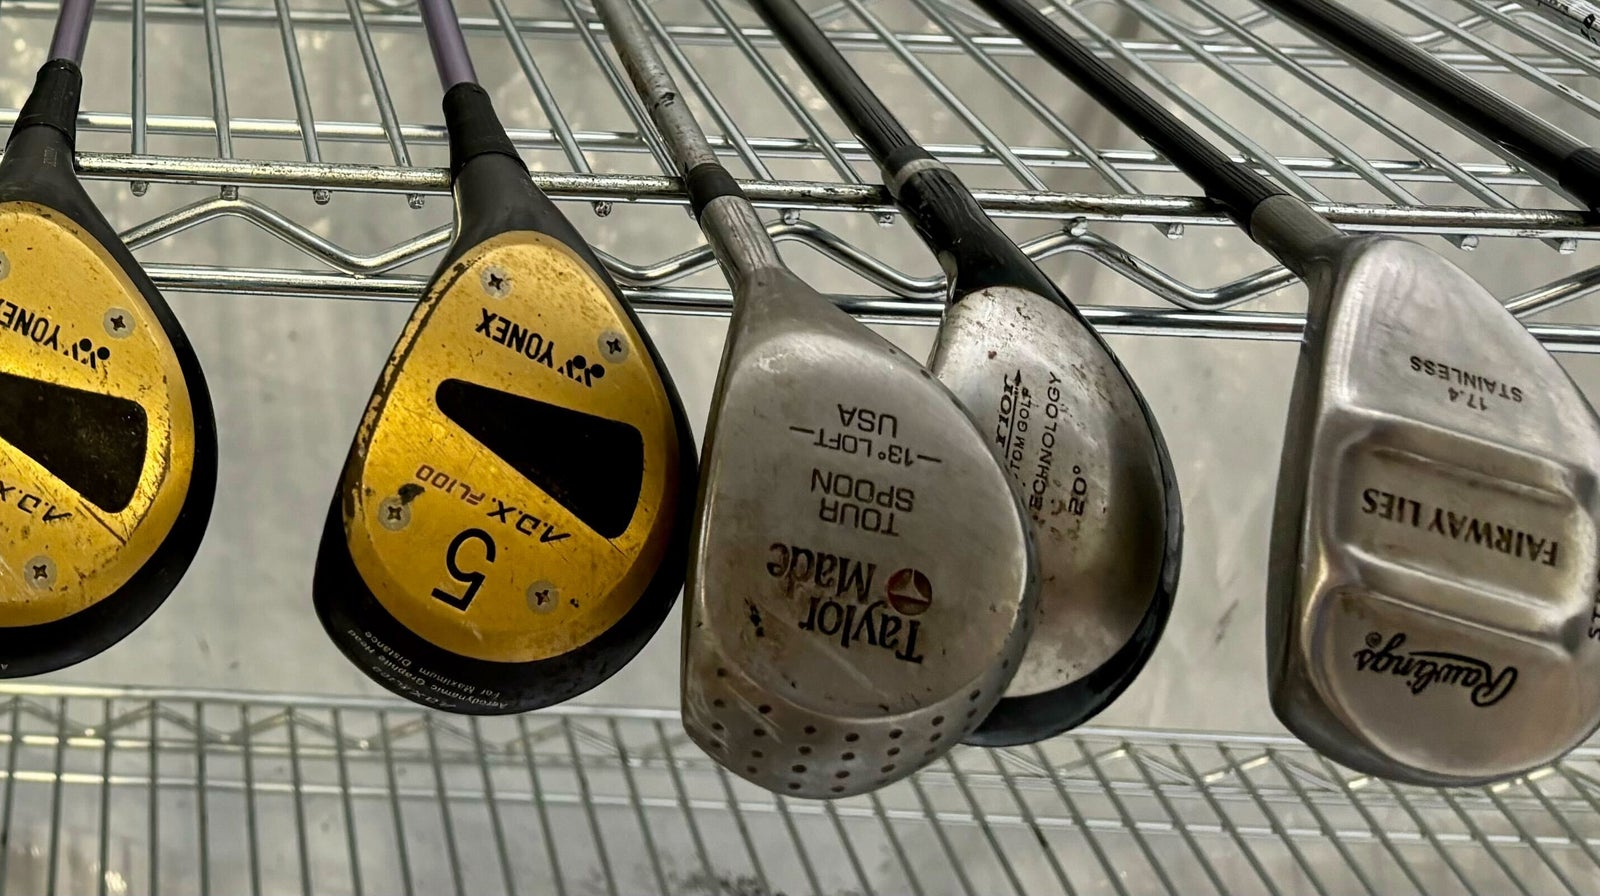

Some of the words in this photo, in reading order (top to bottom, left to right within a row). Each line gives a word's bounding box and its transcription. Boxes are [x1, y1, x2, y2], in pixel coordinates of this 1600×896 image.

[474, 307, 554, 369] YONEX
[1410, 355, 1524, 403] STAINLESS
[1448, 386, 1488, 411] 17.4
[837, 403, 898, 438] USA
[995, 374, 1014, 448] rior
[1017, 387, 1032, 434] GOLF
[415, 464, 486, 505] FL100
[810, 468, 915, 513] SPOON
[1068, 464, 1088, 516] 20°
[819, 497, 900, 537] TOUR
[1362, 488, 1421, 528] LIES
[1428, 506, 1559, 567] FAIRWAY
[431, 528, 496, 612] 5
[766, 542, 877, 605] Made
[348, 629, 375, 654] Head
[365, 631, 412, 667] Distance
[798, 596, 924, 665] Taylor
[419, 667, 476, 695] Maximum
[1353, 632, 1519, 707] Rawlings
[430, 684, 508, 710] Aerodynamic
[481, 688, 501, 699] For
